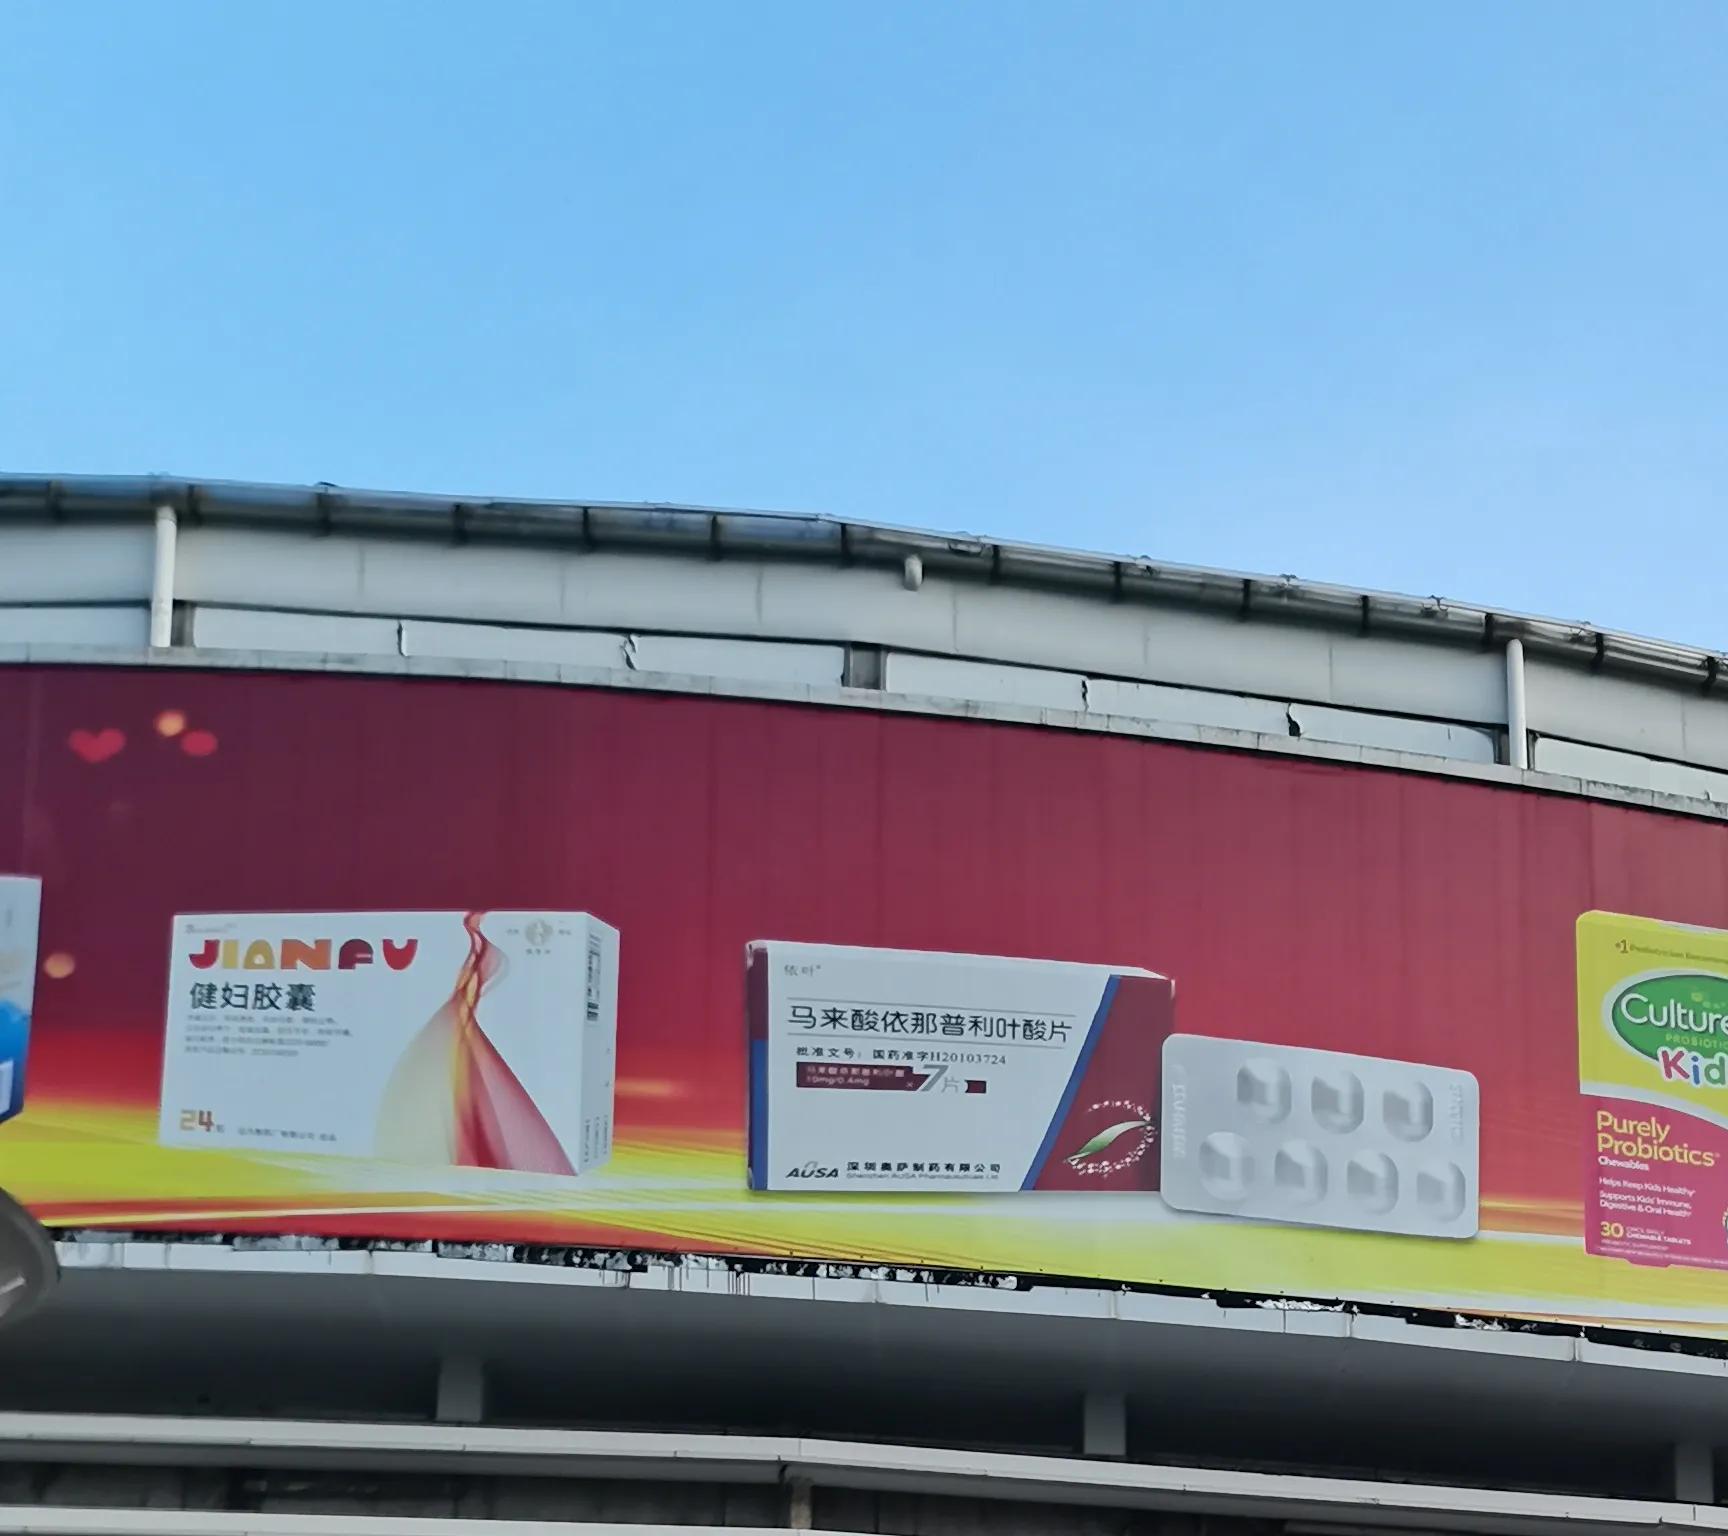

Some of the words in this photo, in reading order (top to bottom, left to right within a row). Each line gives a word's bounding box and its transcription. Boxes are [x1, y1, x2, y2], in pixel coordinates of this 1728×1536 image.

[189, 982, 317, 1012] 健妇胶囊
[787, 1005, 1074, 1044] 马来酸依那普利叶酸片
[1597, 1111, 1671, 1141] Purely
[1597, 1133, 1715, 1167] Probiotics
[1600, 1221, 1625, 1239] 30
